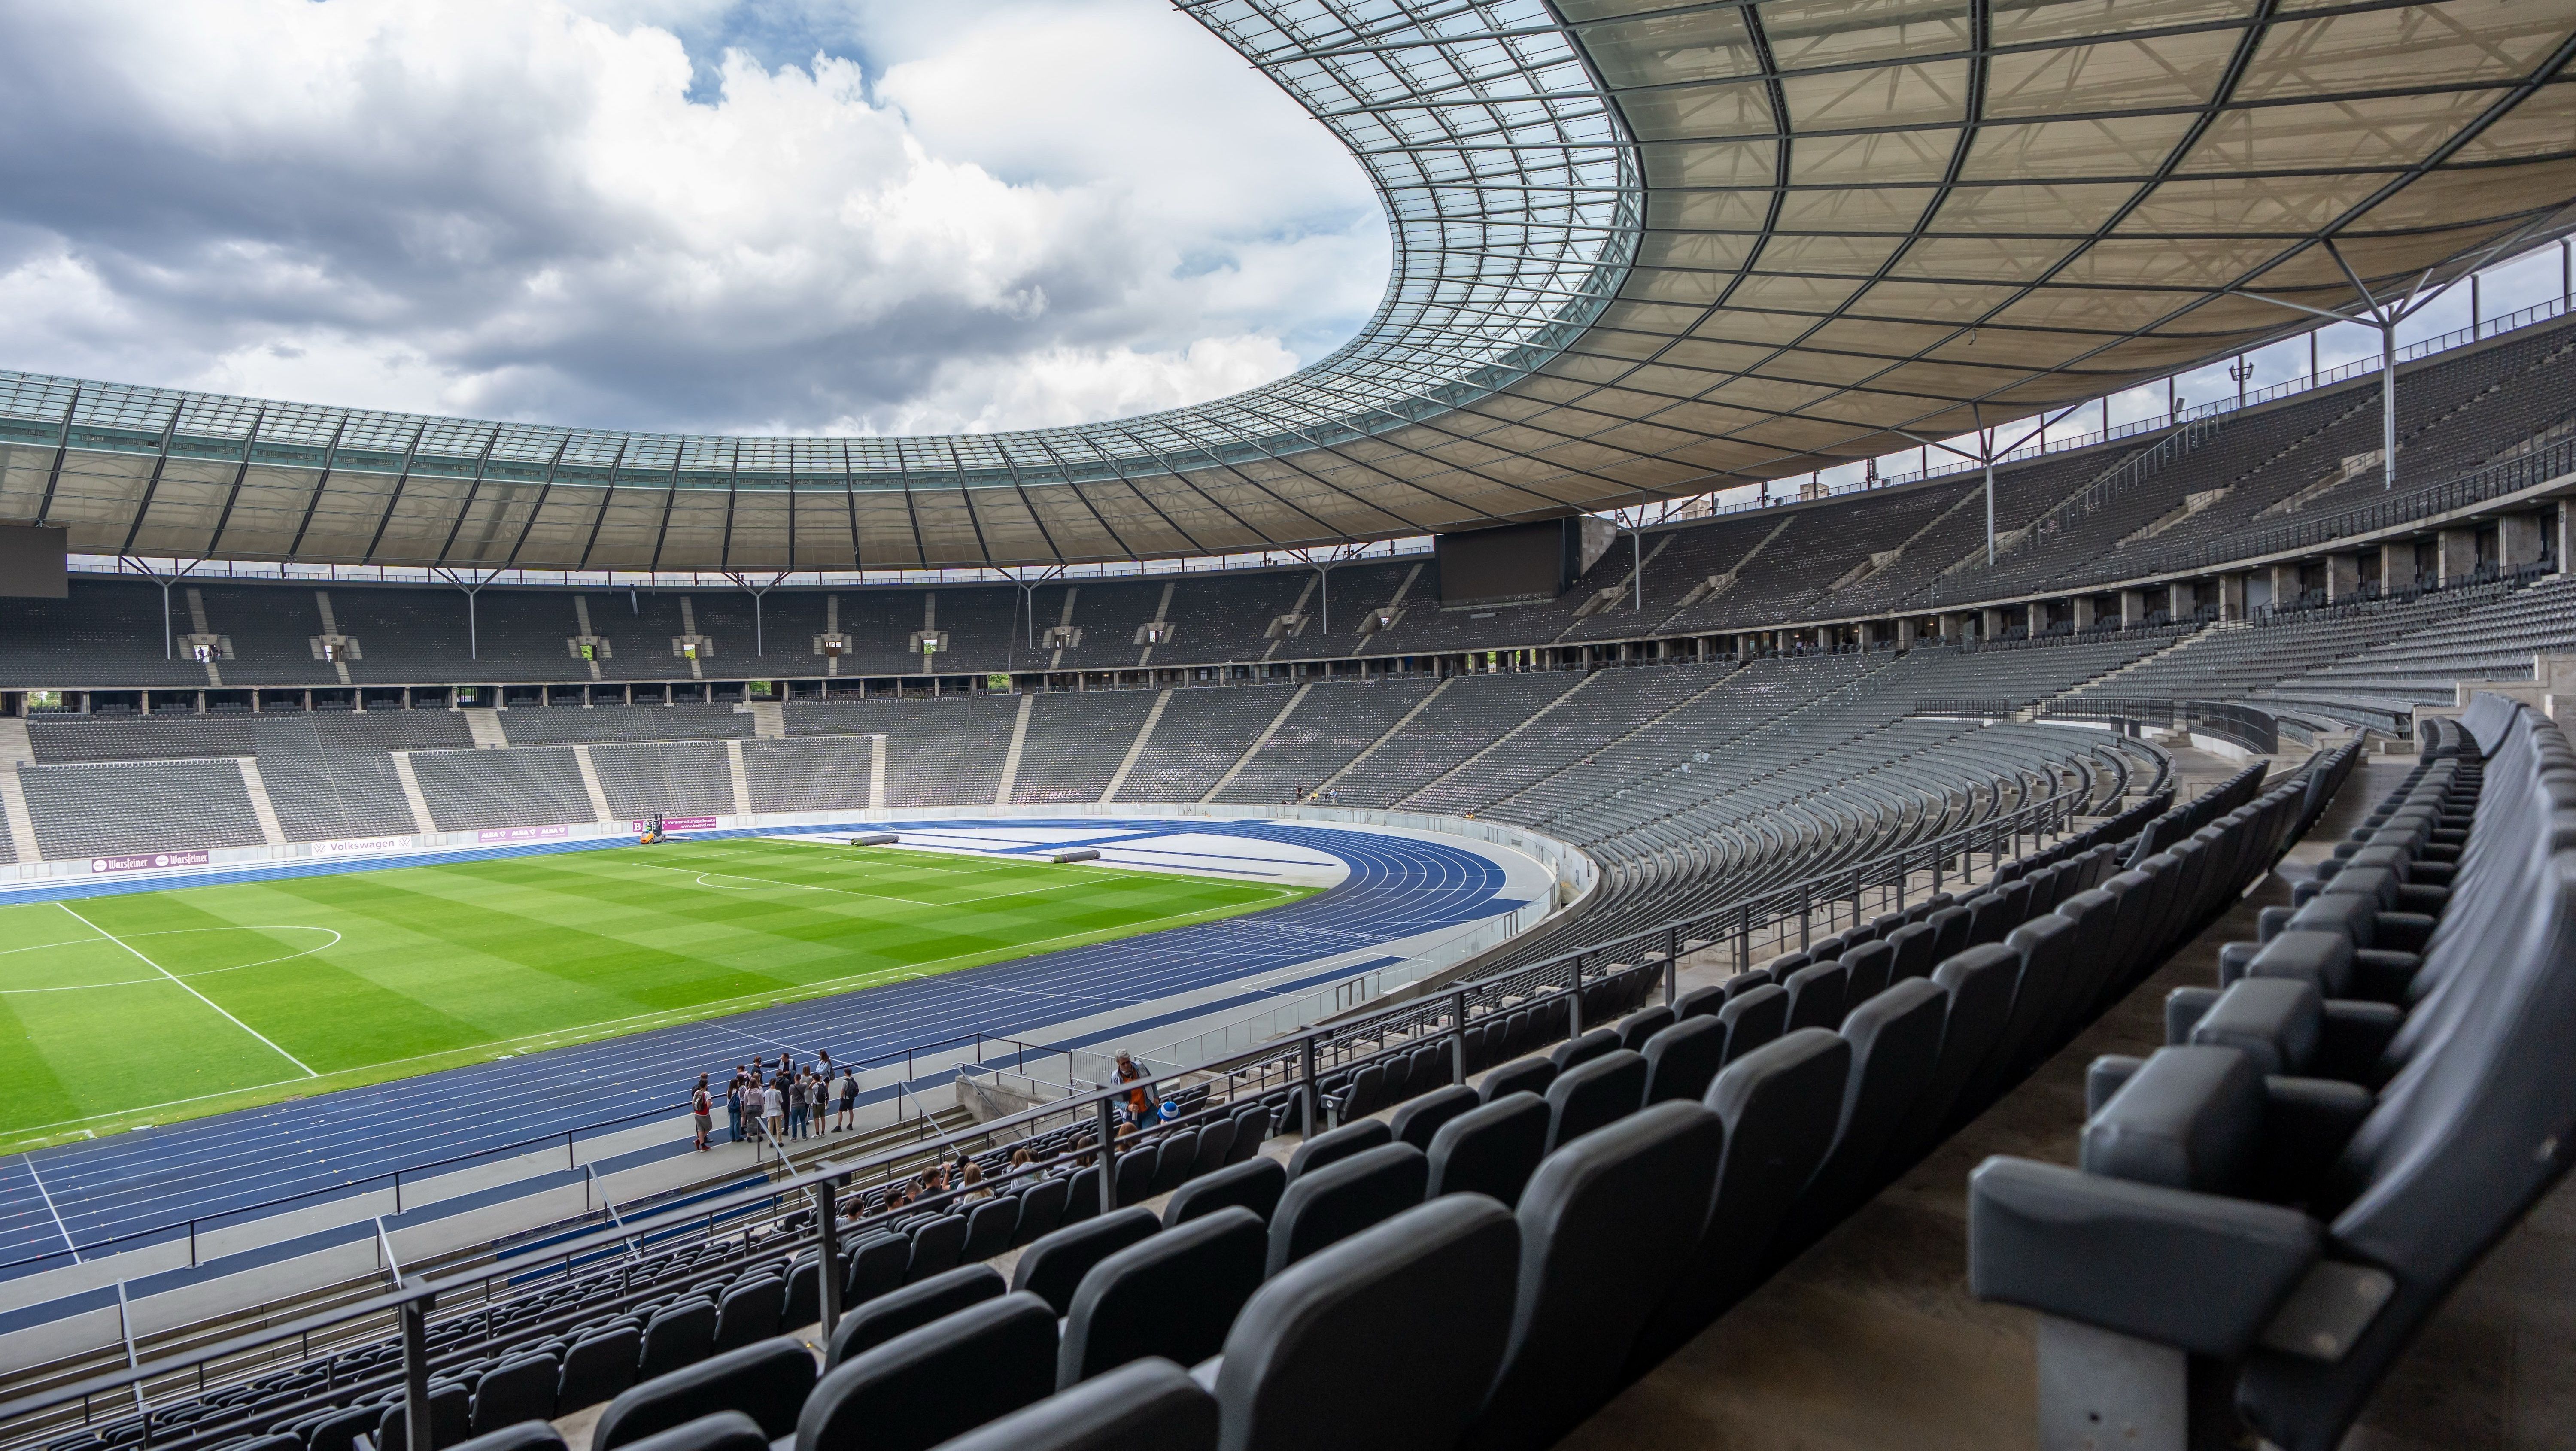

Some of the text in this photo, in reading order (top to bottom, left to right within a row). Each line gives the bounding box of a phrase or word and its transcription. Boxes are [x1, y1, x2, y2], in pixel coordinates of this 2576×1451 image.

[2560, 511, 2564, 523] B
[2440, 540, 2444, 551] B
[330, 841, 394, 850] Volkswagen
[108, 858, 148, 869] Warsteiner
[170, 853, 207, 864] Warsteiner
